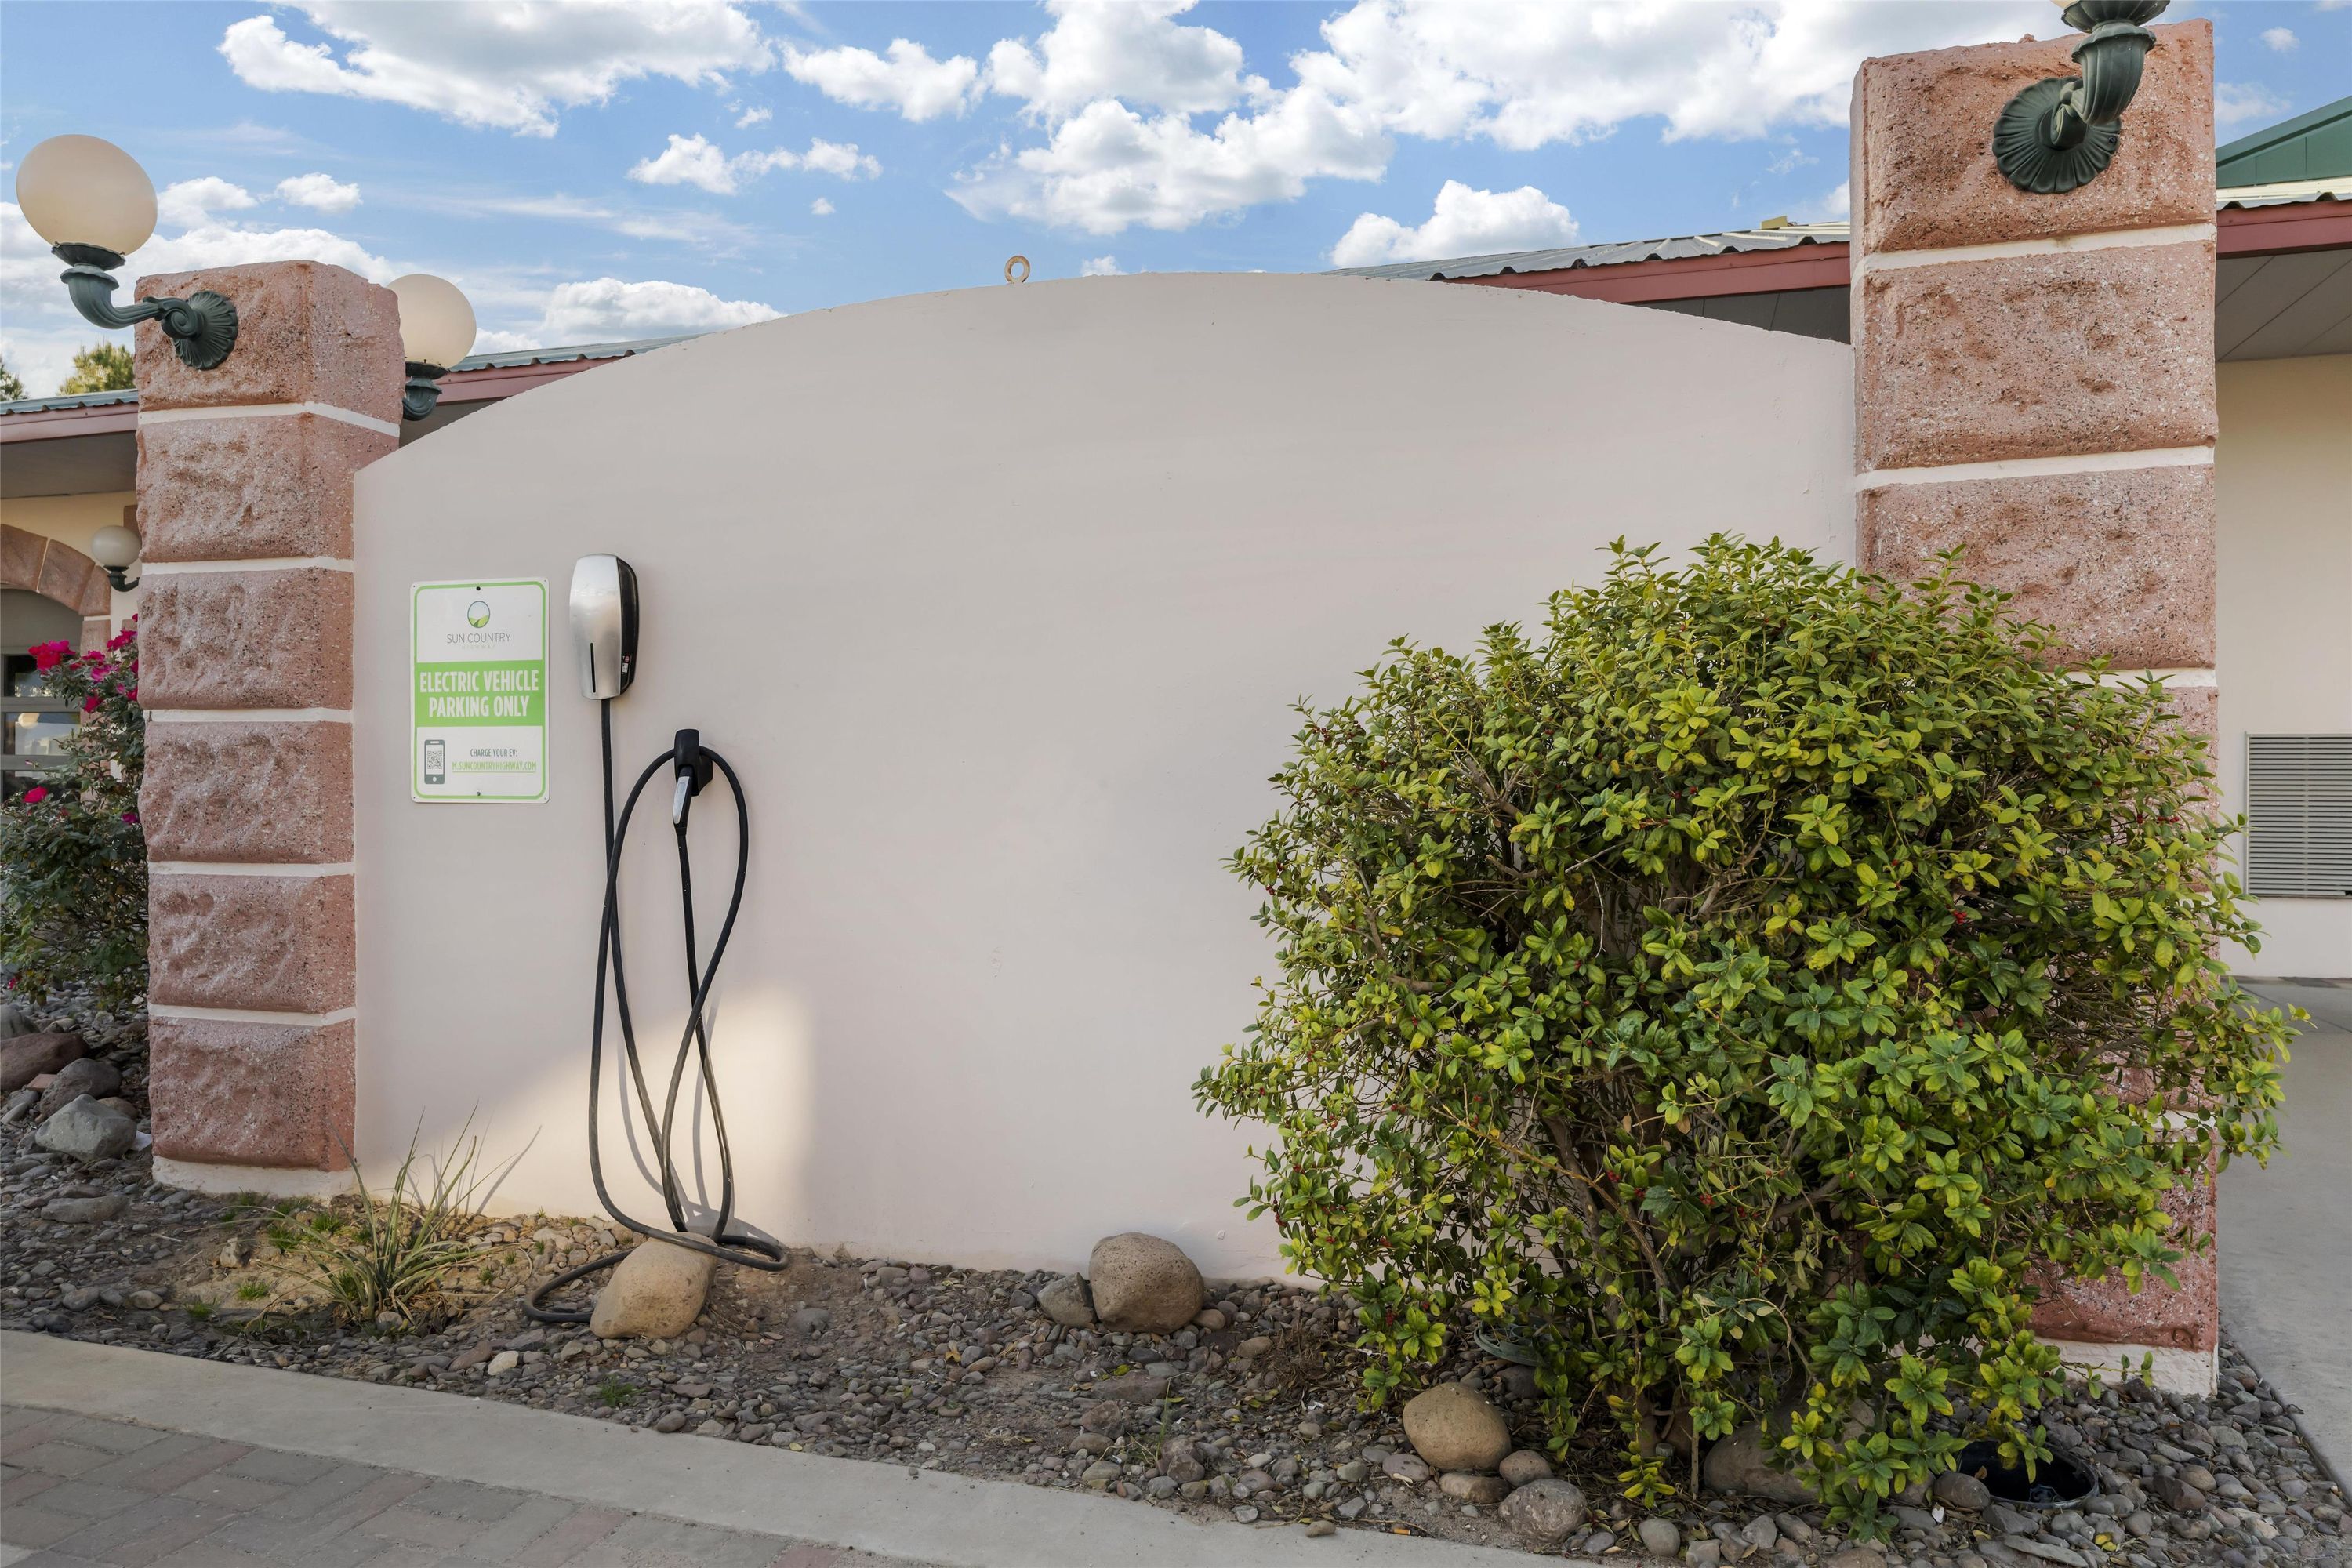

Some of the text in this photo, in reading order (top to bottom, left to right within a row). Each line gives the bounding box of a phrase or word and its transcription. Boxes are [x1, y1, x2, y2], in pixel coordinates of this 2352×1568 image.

[446, 632, 511, 644] SUN COUNTRY
[419, 670, 539, 692] ELECTRIC VEHICLE
[428, 695, 530, 717] PARKING ONLY
[470, 748, 518, 757] CHARGE YOUR EV:
